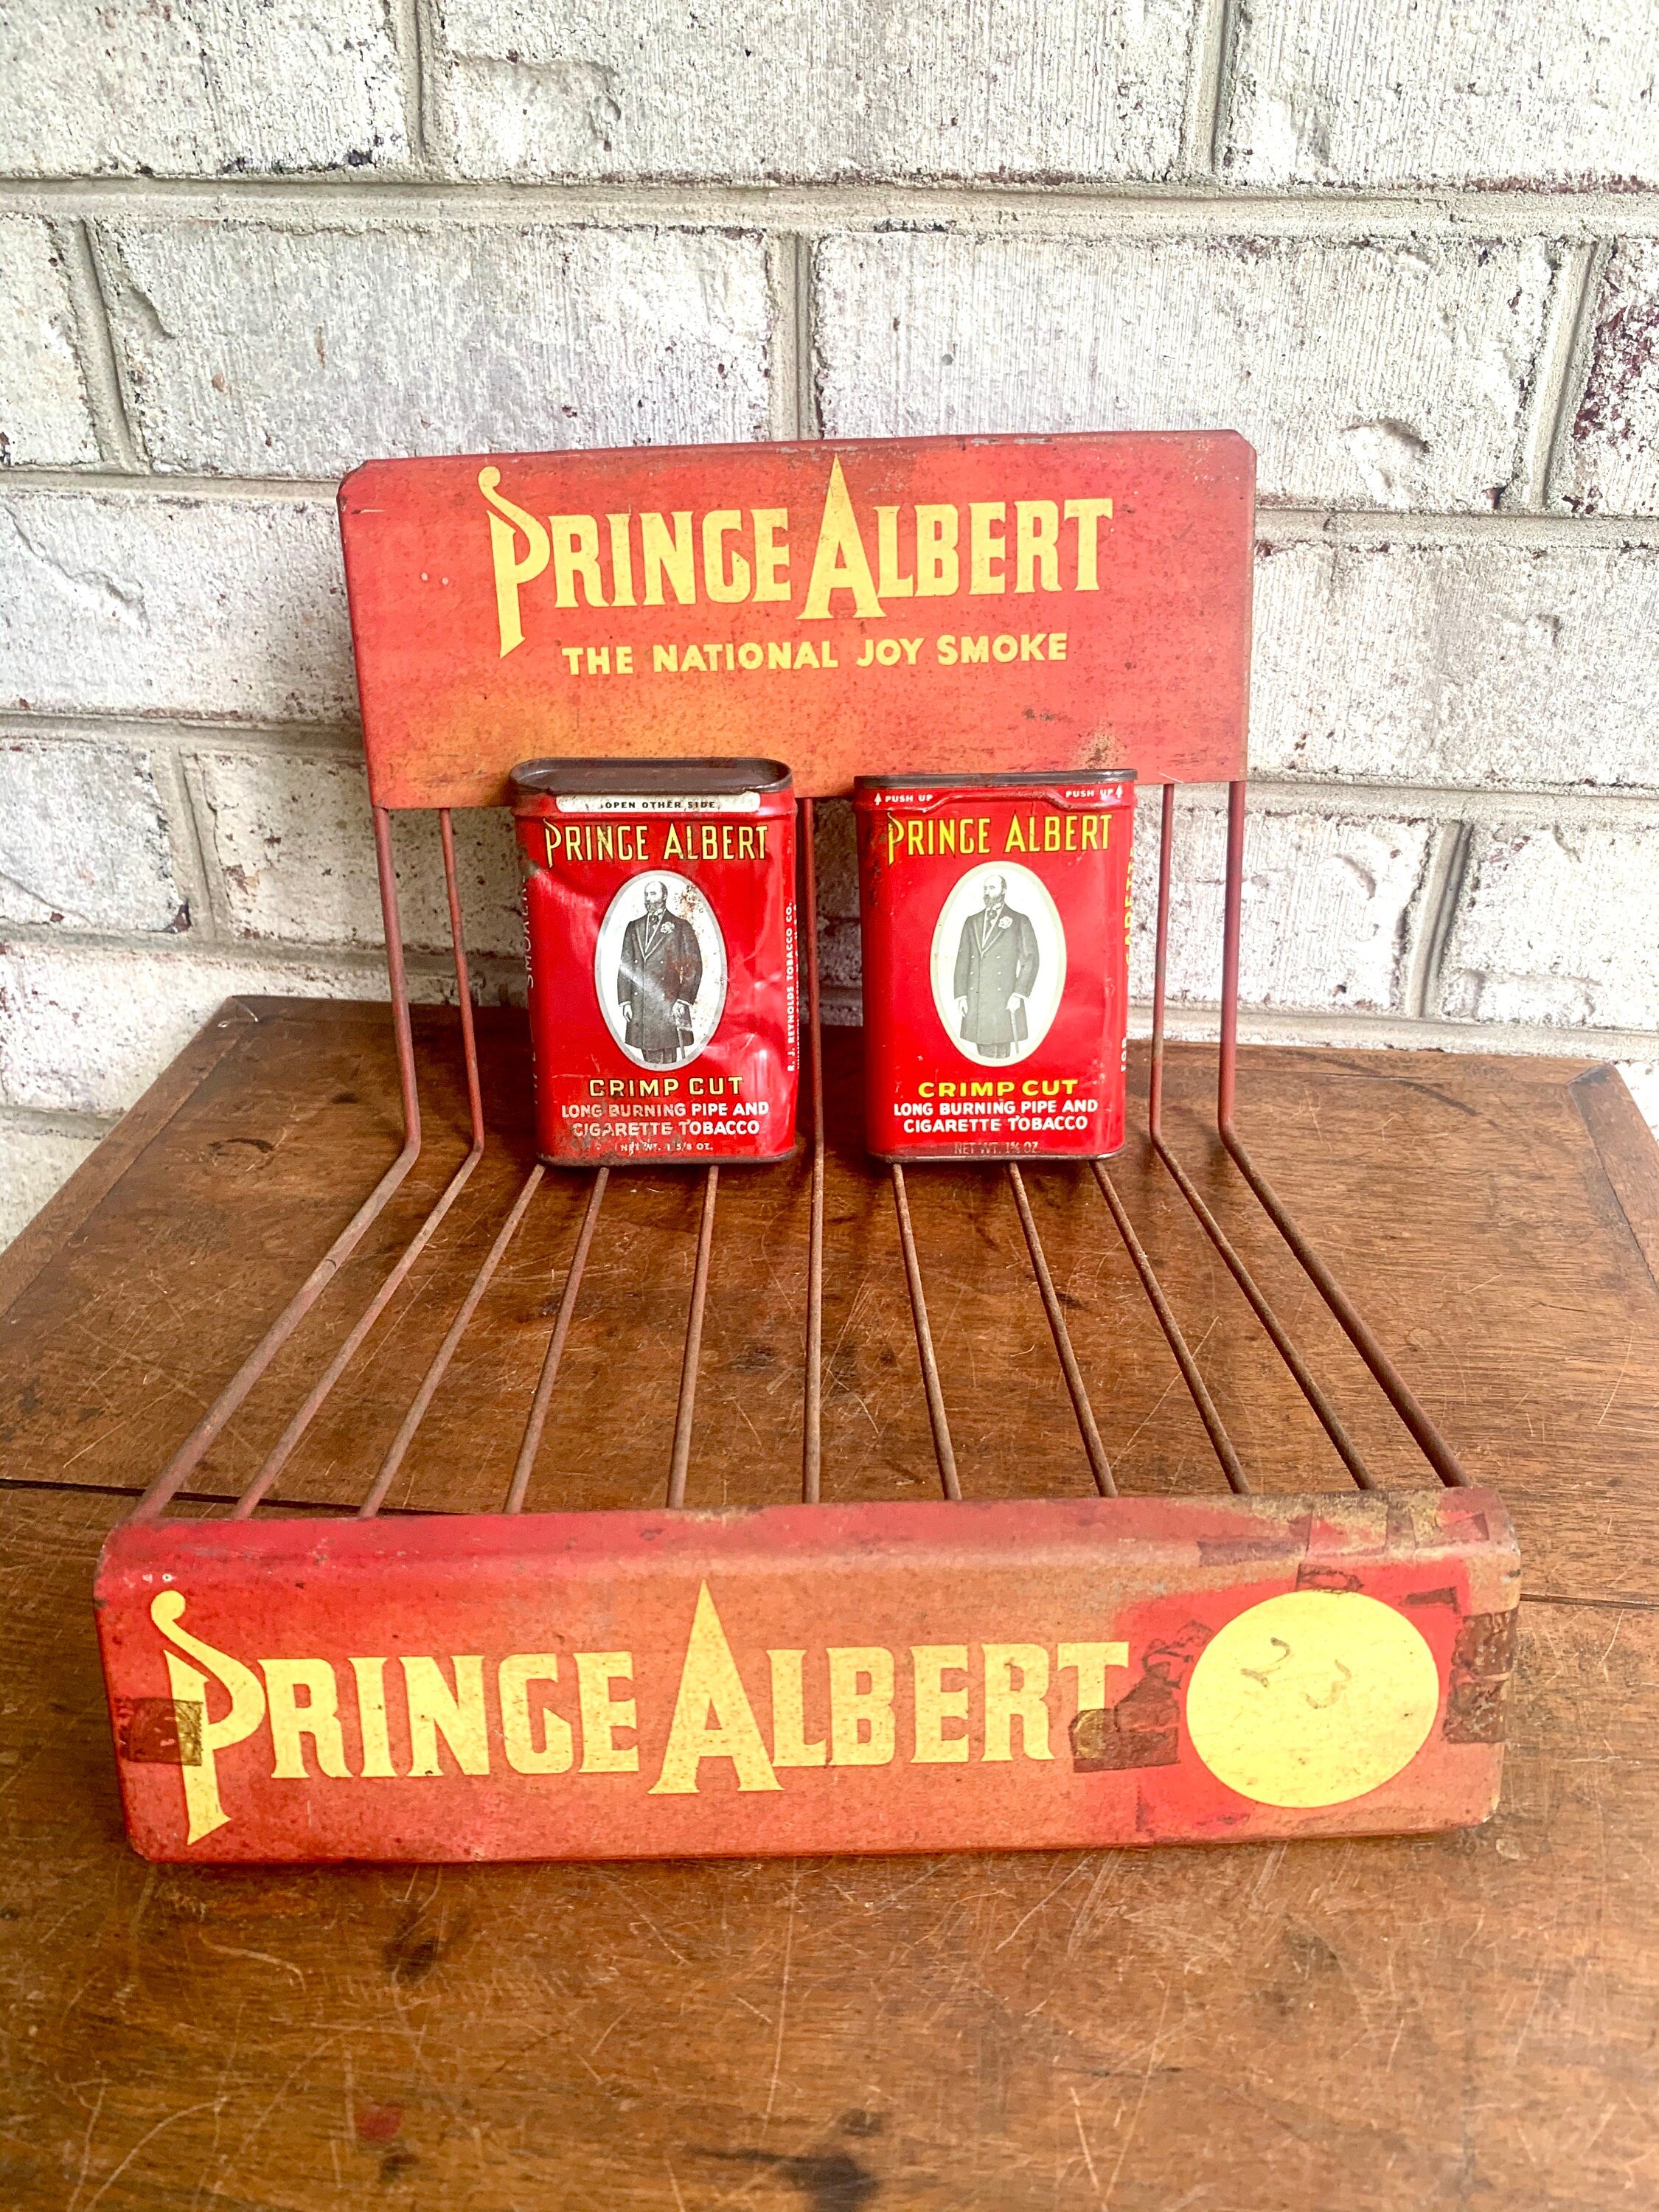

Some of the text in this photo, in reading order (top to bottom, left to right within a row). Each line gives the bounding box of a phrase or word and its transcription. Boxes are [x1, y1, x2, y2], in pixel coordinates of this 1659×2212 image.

[478, 453, 1113, 658] PRINCE ALBERT
[561, 632, 1067, 675] THE NATIONAL JOY SMOKE
[1065, 788, 1113, 798] PUSH UP
[605, 800, 715, 810] OPEN OTHER SIDE
[543, 818, 768, 869] PRINCE ALBERT
[887, 812, 1113, 866] PRINCE ALBERT
[785, 928, 794, 982] TOBACCO
[786, 986, 796, 1044] REYNOLDS
[787, 1048, 796, 1057] J.
[787, 1061, 796, 1071] R.
[589, 1076, 744, 1098] CRIMP CUT
[918, 1079, 1079, 1098] CRIMP CUT
[561, 1102, 769, 1118] LONG BURNING PIPE AND
[894, 1099, 1098, 1116] LONG BURNING PIPE AND
[573, 1120, 759, 1137] CIGARETTE TOBACCO
[903, 1116, 1088, 1133] CIGARETTE TOBACCO
[696, 1142, 714, 1150] OZ.
[954, 1142, 975, 1154] NET
[150, 1579, 1129, 1845] PRINCE ALBERT
